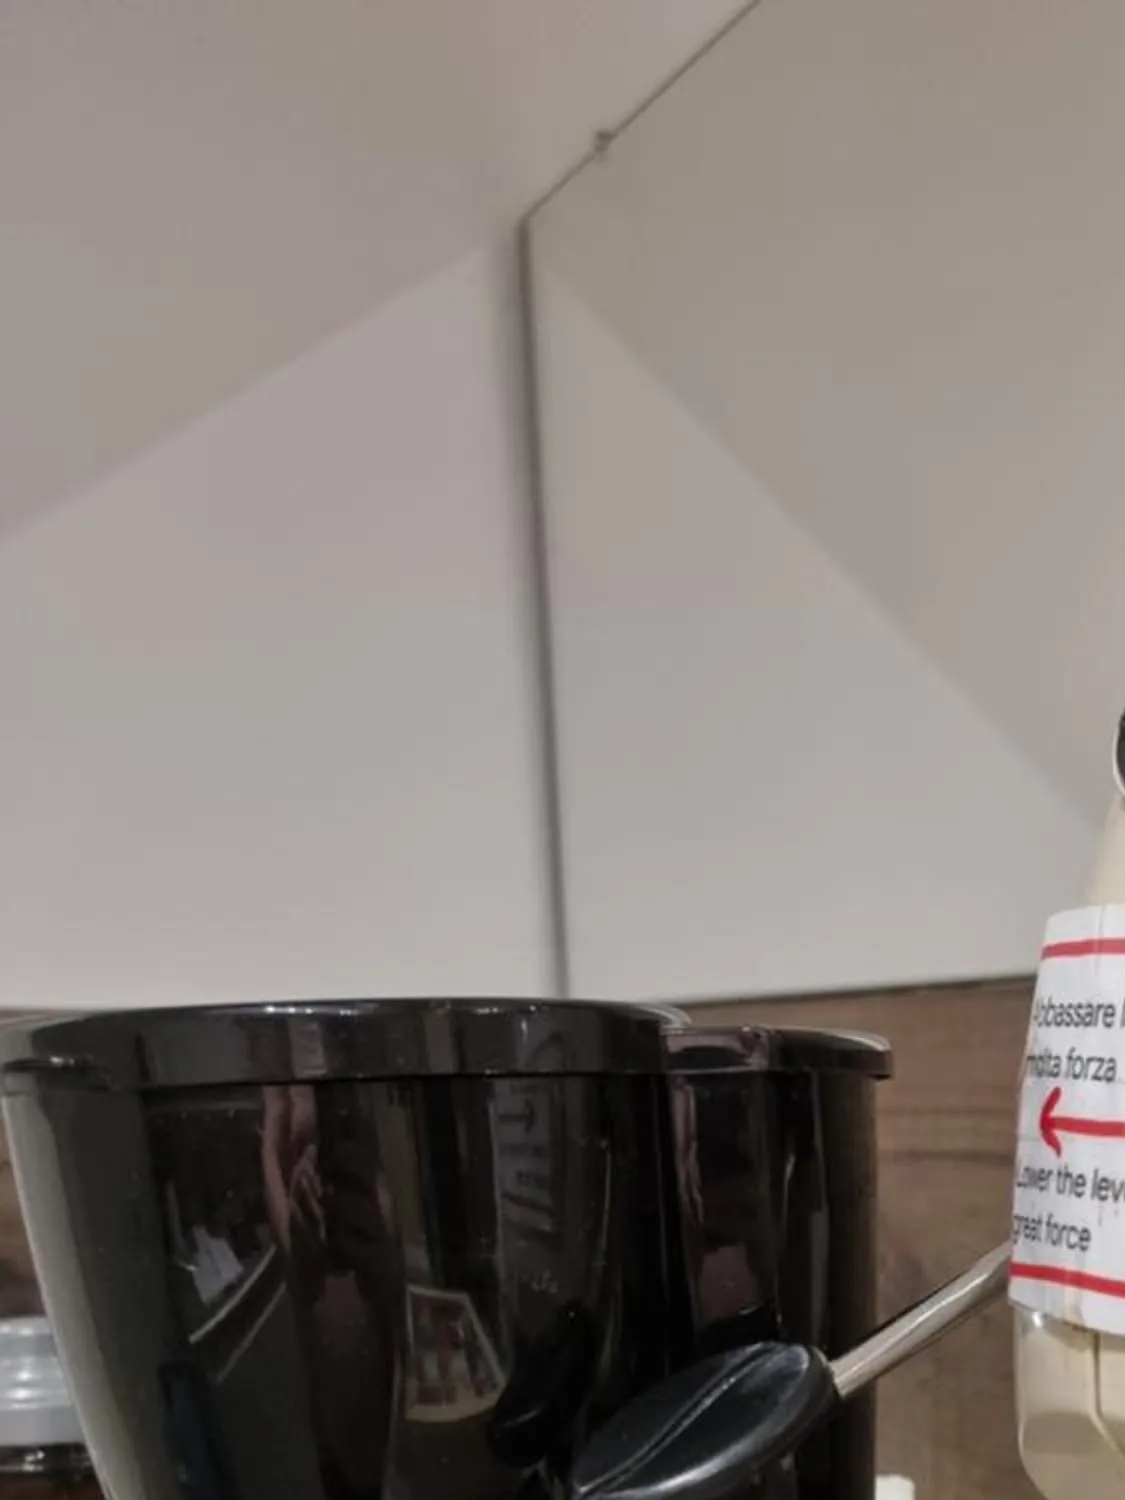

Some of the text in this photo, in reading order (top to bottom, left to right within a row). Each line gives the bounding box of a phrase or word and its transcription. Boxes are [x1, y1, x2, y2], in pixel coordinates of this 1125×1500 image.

[1064, 1045, 1118, 1084] forza
[1056, 1162, 1087, 1199] the
[1044, 1212, 1092, 1254] force
